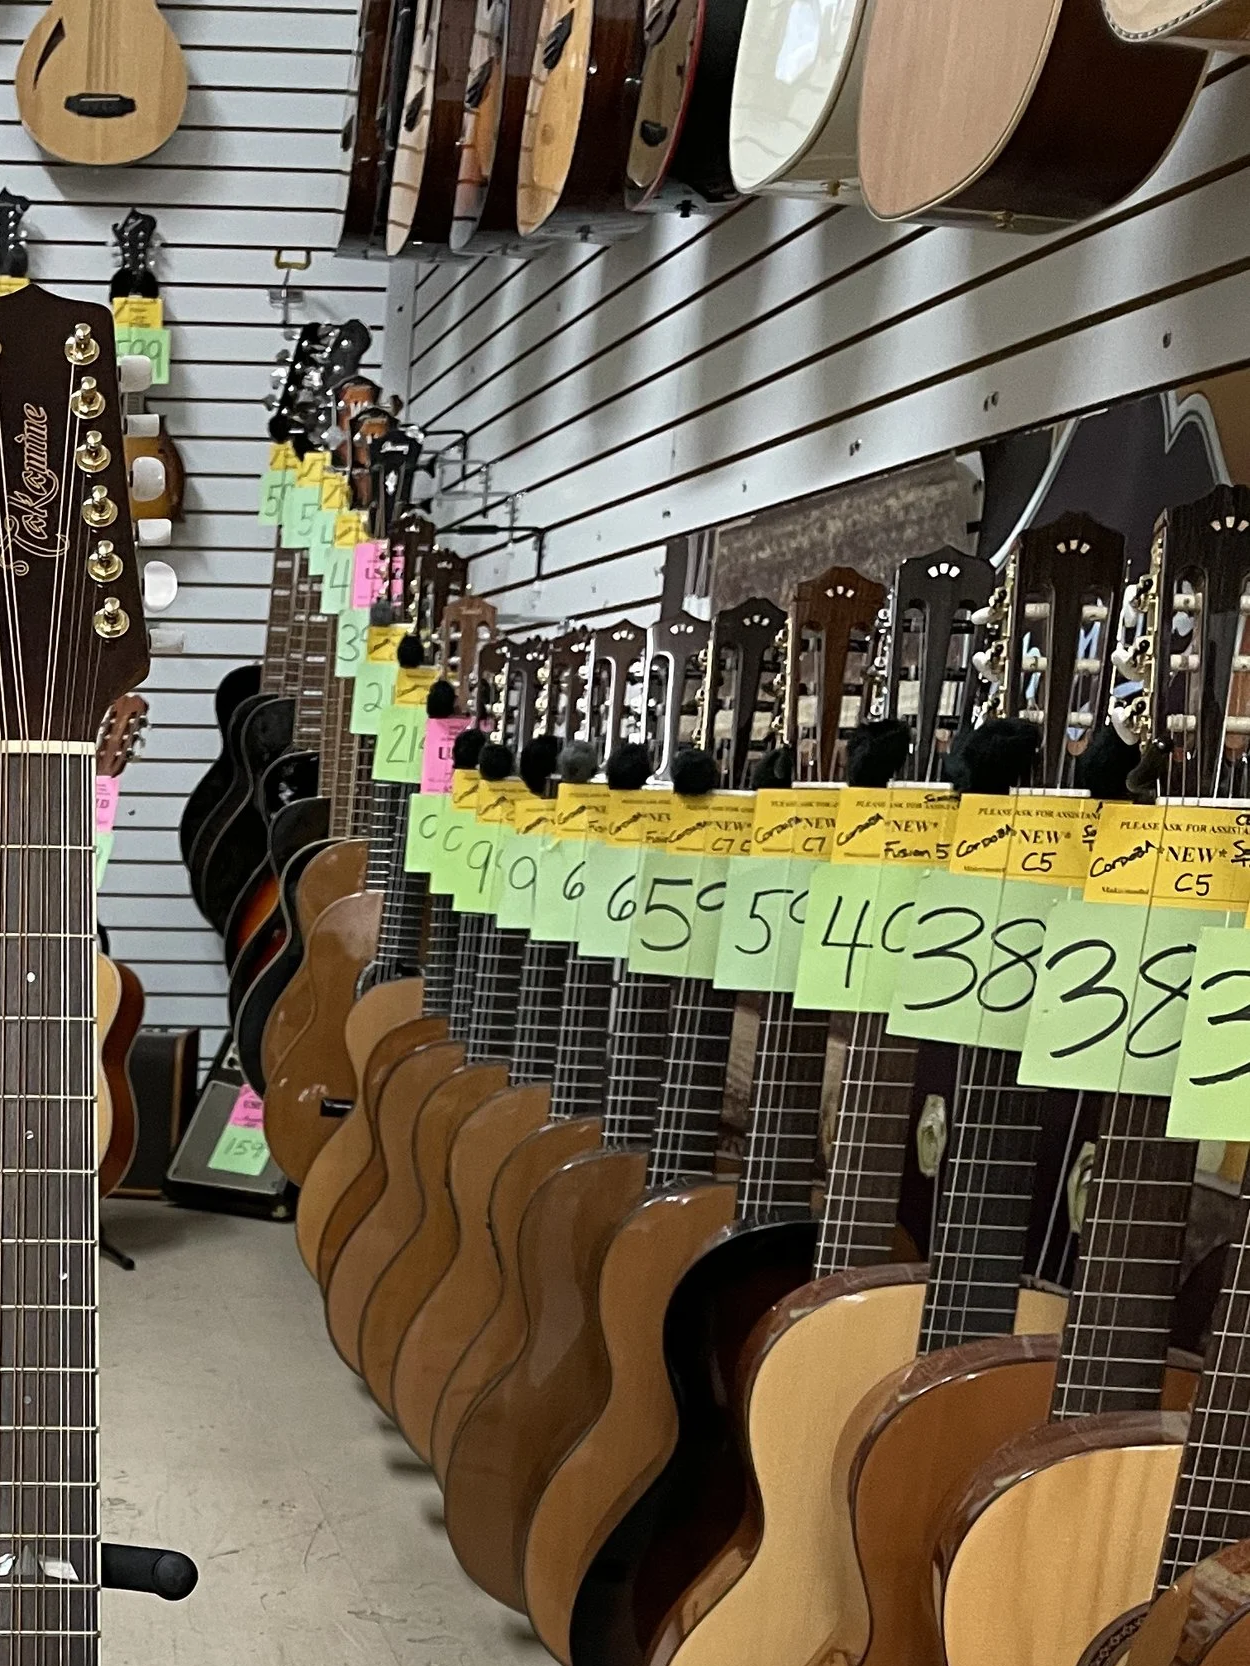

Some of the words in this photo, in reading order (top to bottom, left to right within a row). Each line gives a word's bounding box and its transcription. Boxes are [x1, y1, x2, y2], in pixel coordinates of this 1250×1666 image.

[977, 808, 1013, 816] PLEASE
[1014, 809, 1033, 817] ASK
[1036, 810, 1055, 818] FOR
[1119, 821, 1160, 831] PLEASE
[1163, 823, 1183, 832] ASK
[1186, 824, 1207, 833] FOR
[802, 836, 827, 852] C7
[935, 843, 952, 859] 5
[1021, 852, 1057, 873] C5
[1174, 872, 1214, 897] C5
[223, 1138, 264, 1158] 159
